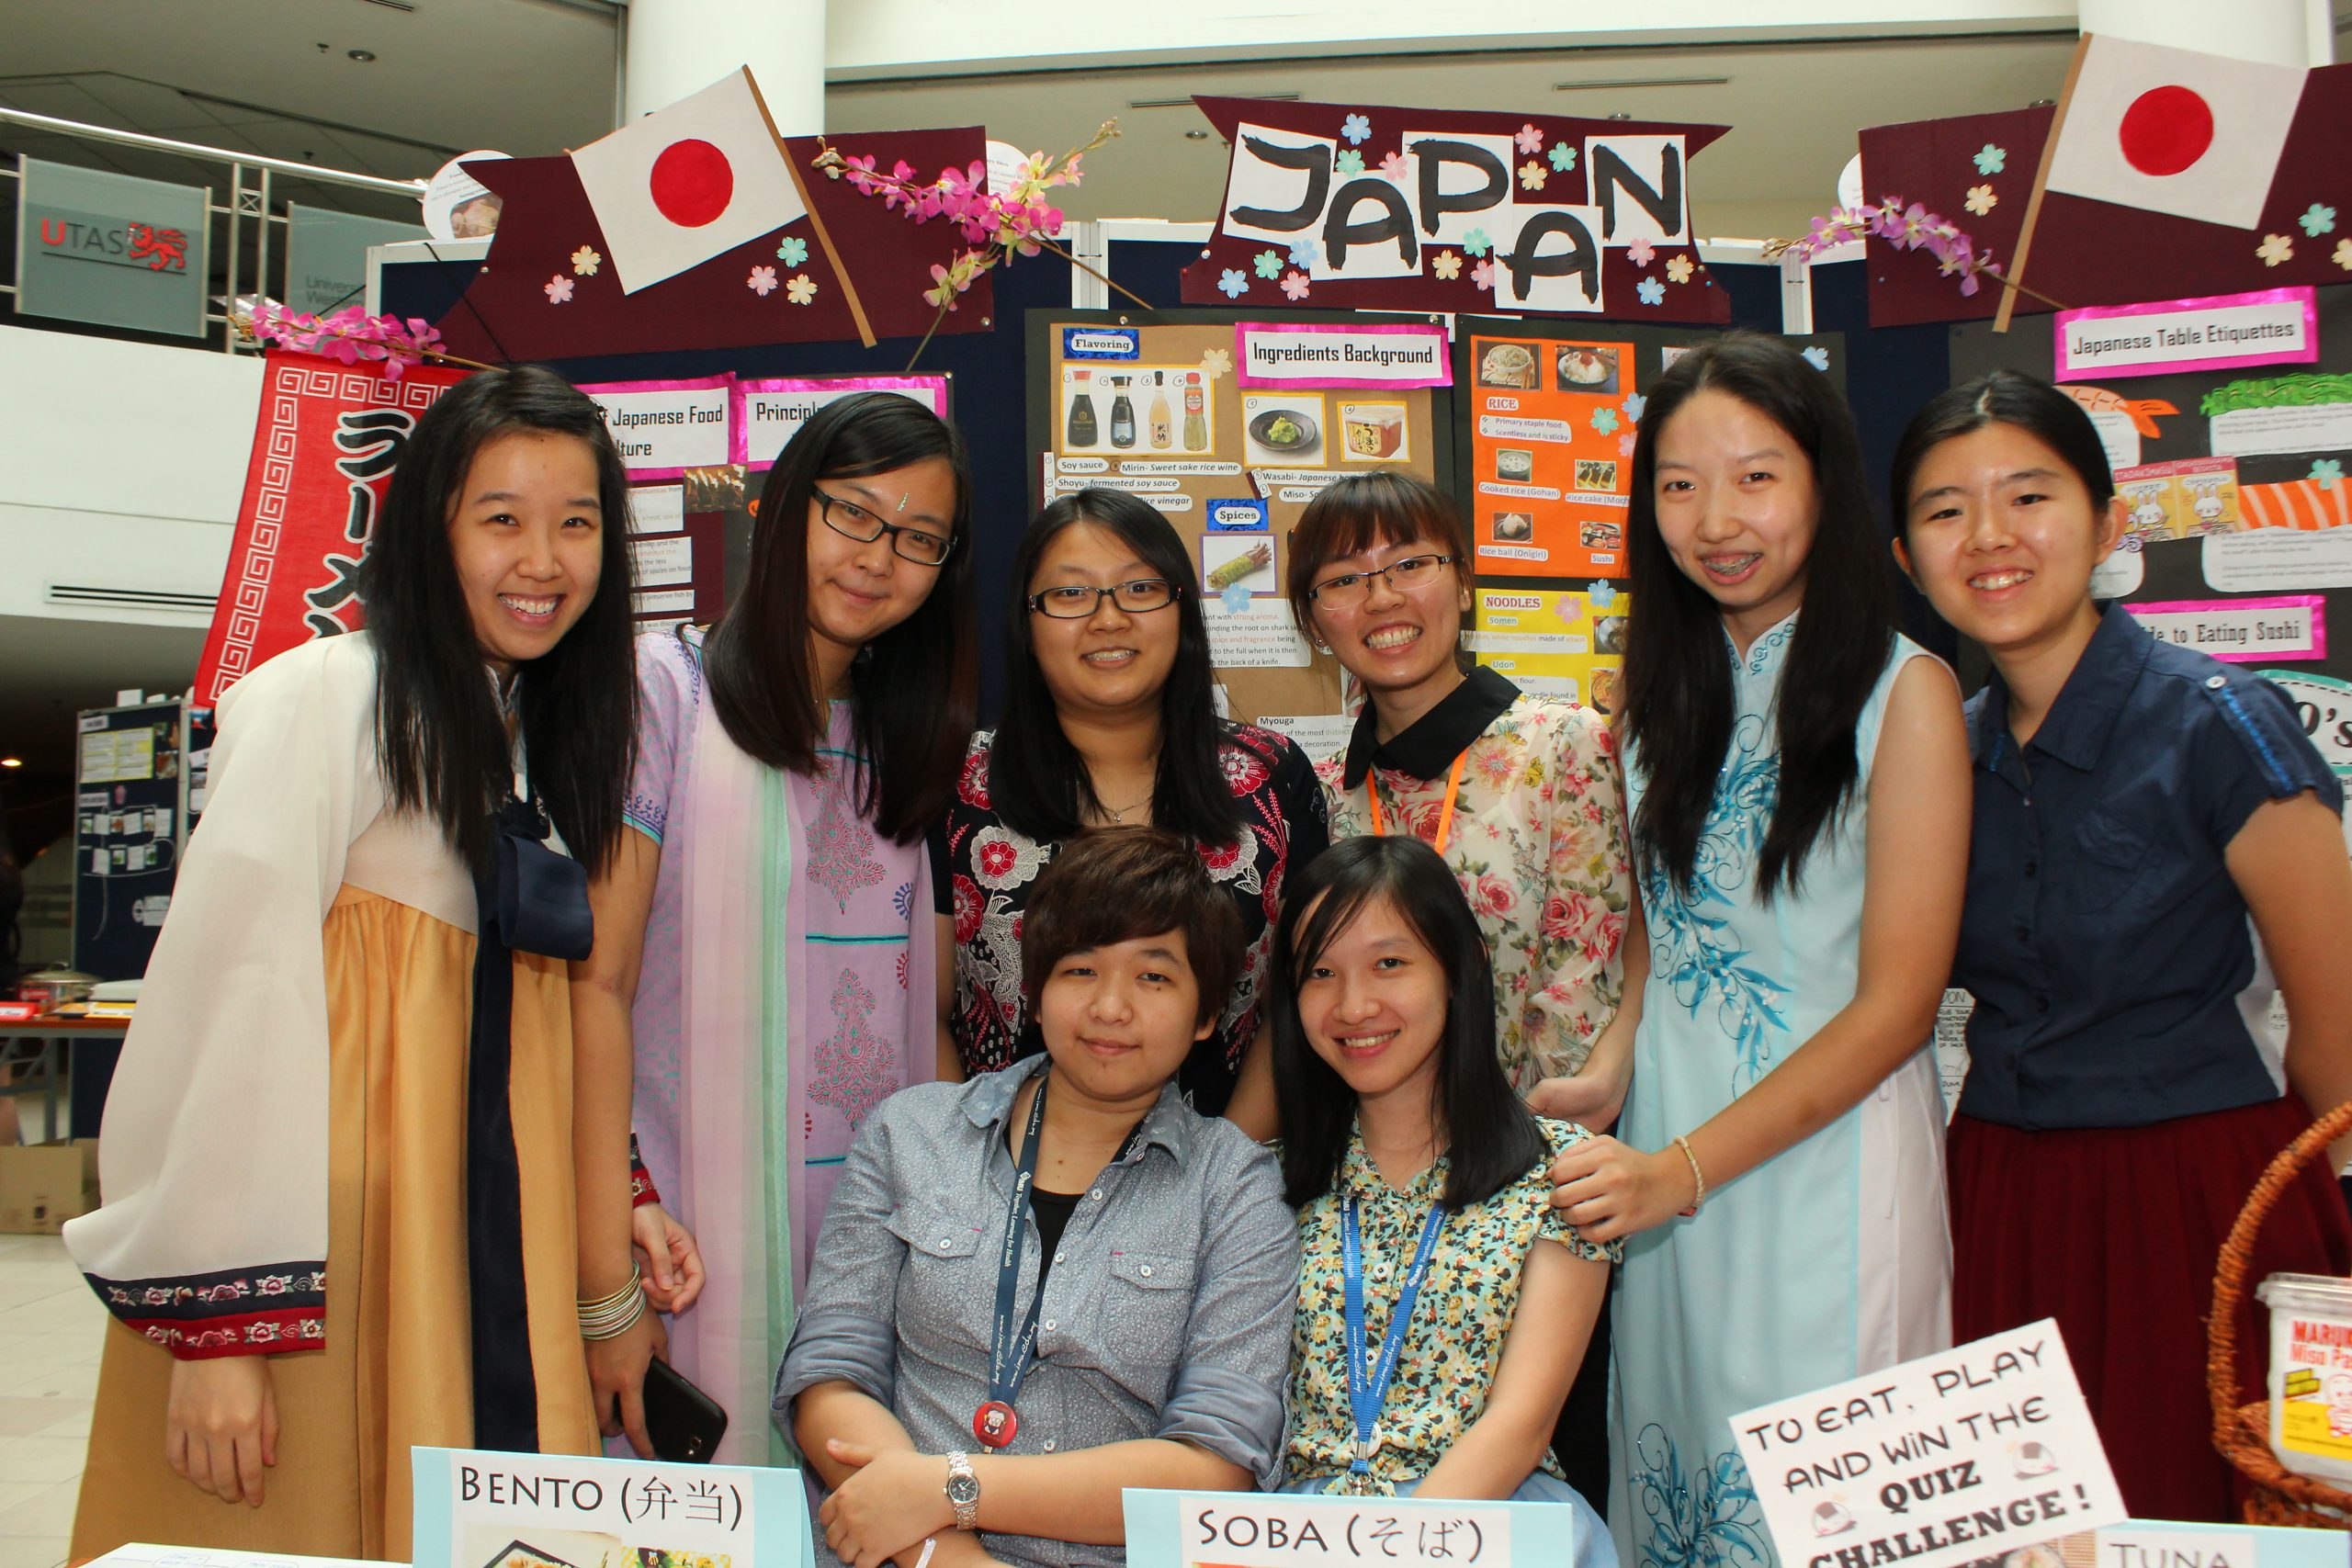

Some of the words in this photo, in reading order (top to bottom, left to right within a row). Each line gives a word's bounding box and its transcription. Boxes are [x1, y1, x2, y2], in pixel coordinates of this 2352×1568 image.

[1229, 132, 1682, 304] JAPAN
[41, 219, 125, 255] UTAS
[1075, 338, 1130, 351] Flavoring
[2074, 335, 2152, 355] Japanese
[2157, 329, 2200, 347] Table
[2207, 323, 2294, 344] Etiquettes
[1253, 342, 1340, 363] Ingredients
[1344, 344, 1433, 366] Background
[1488, 399, 1517, 410] RICE
[613, 408, 684, 430] Japanese
[689, 404, 723, 423] Food
[1496, 418, 1522, 426] Primary
[1546, 421, 1562, 429] food
[1061, 461, 1077, 469] Soy
[1079, 461, 1103, 469] sauce
[1122, 463, 1148, 471] Mirin-
[1150, 463, 1176, 471] Sweet
[1178, 463, 1198, 471] sake
[1090, 479, 1135, 489] fermented
[1136, 480, 1150, 489] soy
[1262, 473, 1296, 481] Wasabi-
[1298, 474, 1337, 483] Japanese
[1283, 491, 1307, 499] Miso-
[1479, 483, 1510, 493] Cooked
[1510, 486, 1526, 494] rice
[1527, 487, 1560, 497] (Gohan)
[1158, 497, 1191, 506] vinegar
[1219, 511, 1257, 524] Spices
[1480, 547, 1496, 556] Rice
[1498, 547, 1512, 556] ball
[1514, 548, 1547, 559] (Onigiri)
[1592, 555, 1612, 563] Sushi
[1486, 596, 1541, 608] NOODLES
[1489, 616, 1517, 625] Somen
[2174, 626, 2188, 643] to
[2196, 623, 2247, 645] Eating
[2256, 620, 2300, 640] Sushi
[1244, 637, 1276, 645] fragrance
[1492, 660, 1515, 669] Udon
[1260, 717, 1295, 726] Myouga
[1747, 1416, 1804, 1452] TO
[1931, 1339, 2045, 1399] PLAY
[1781, 1449, 1871, 1495] AND
[1958, 1395, 2052, 1443] THE
[460, 1465, 604, 1512] BENTO
[1878, 1459, 1983, 1516] QUIZ
[620, 1475, 742, 1532] (弁当)
[1197, 1508, 1329, 1552] SOBA
[1346, 1513, 1484, 1564] (そば)
